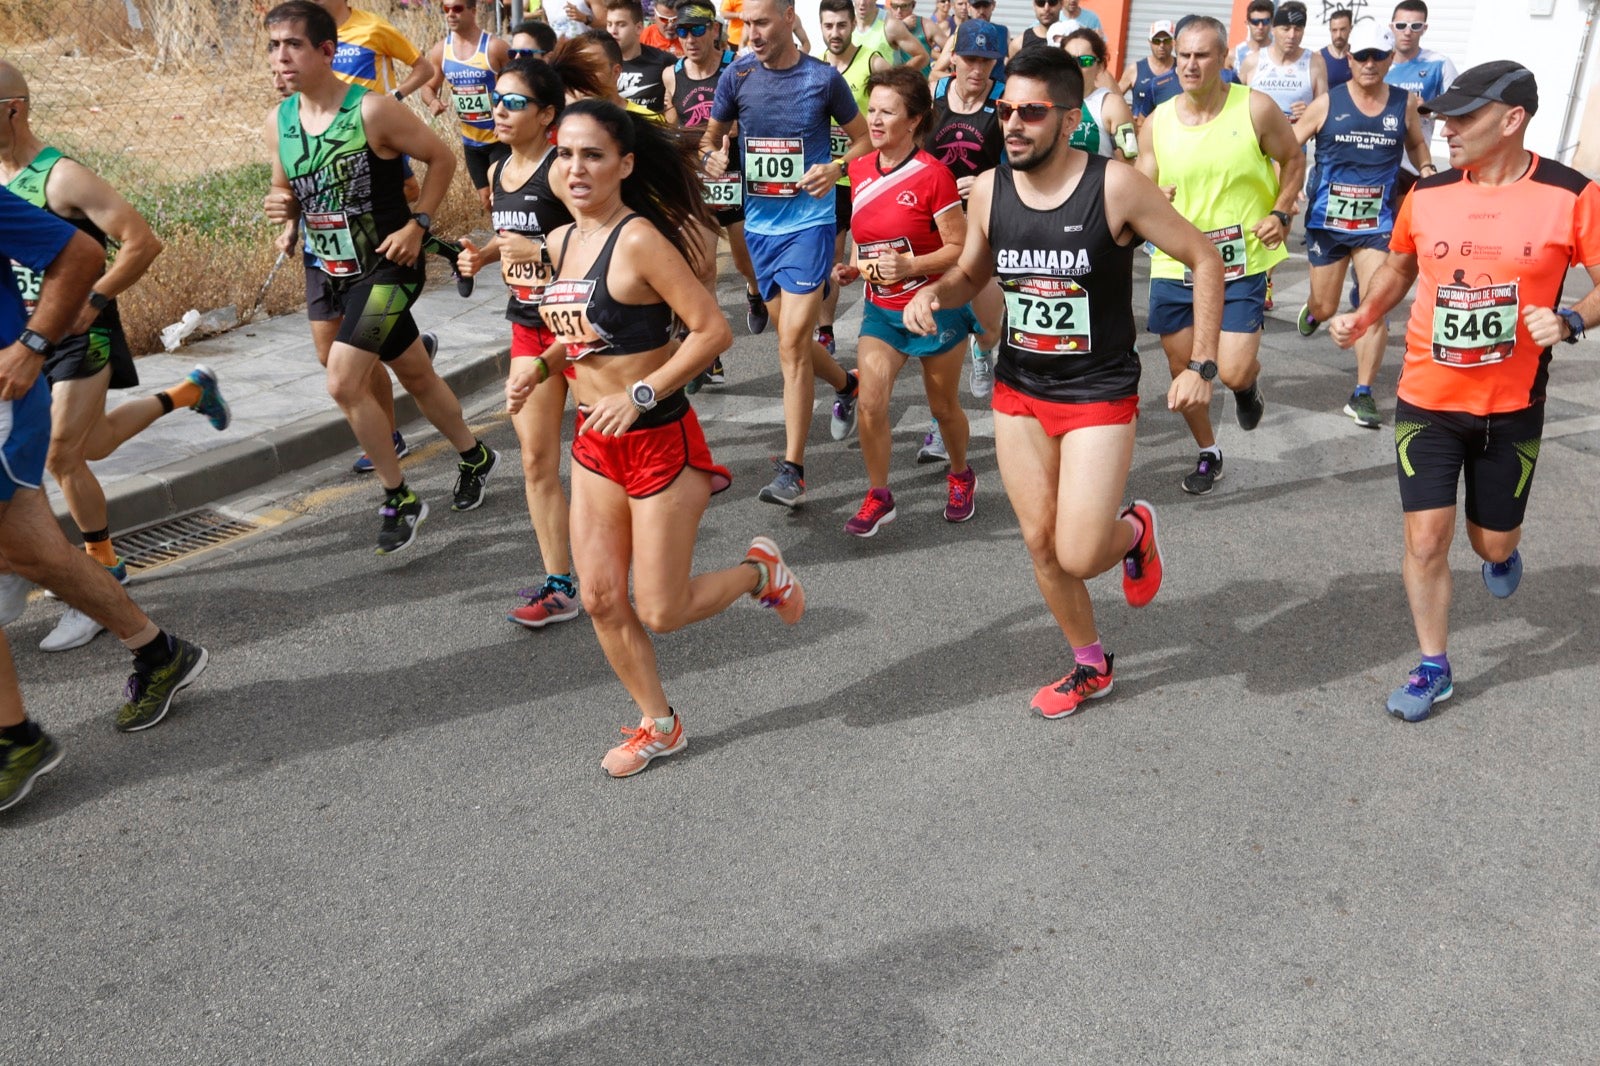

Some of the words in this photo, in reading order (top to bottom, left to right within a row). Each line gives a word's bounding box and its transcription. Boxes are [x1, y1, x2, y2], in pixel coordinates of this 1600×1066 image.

[334, 46, 361, 57] inos
[458, 96, 484, 110] 824
[1335, 135, 1362, 144] PAZITO
[1370, 137, 1397, 146] PAZITO
[754, 156, 794, 178] 109
[1337, 199, 1374, 217] 717
[997, 249, 1091, 270] GRANADA
[507, 261, 547, 280] 2098
[1051, 268, 1063, 276] RUN
[1064, 266, 1092, 276] PROJECT
[1052, 281, 1060, 290] DE
[1482, 289, 1490, 299] DE
[1491, 287, 1512, 299] FONDO
[1018, 297, 1076, 330] 732
[1444, 311, 1503, 342] 546
